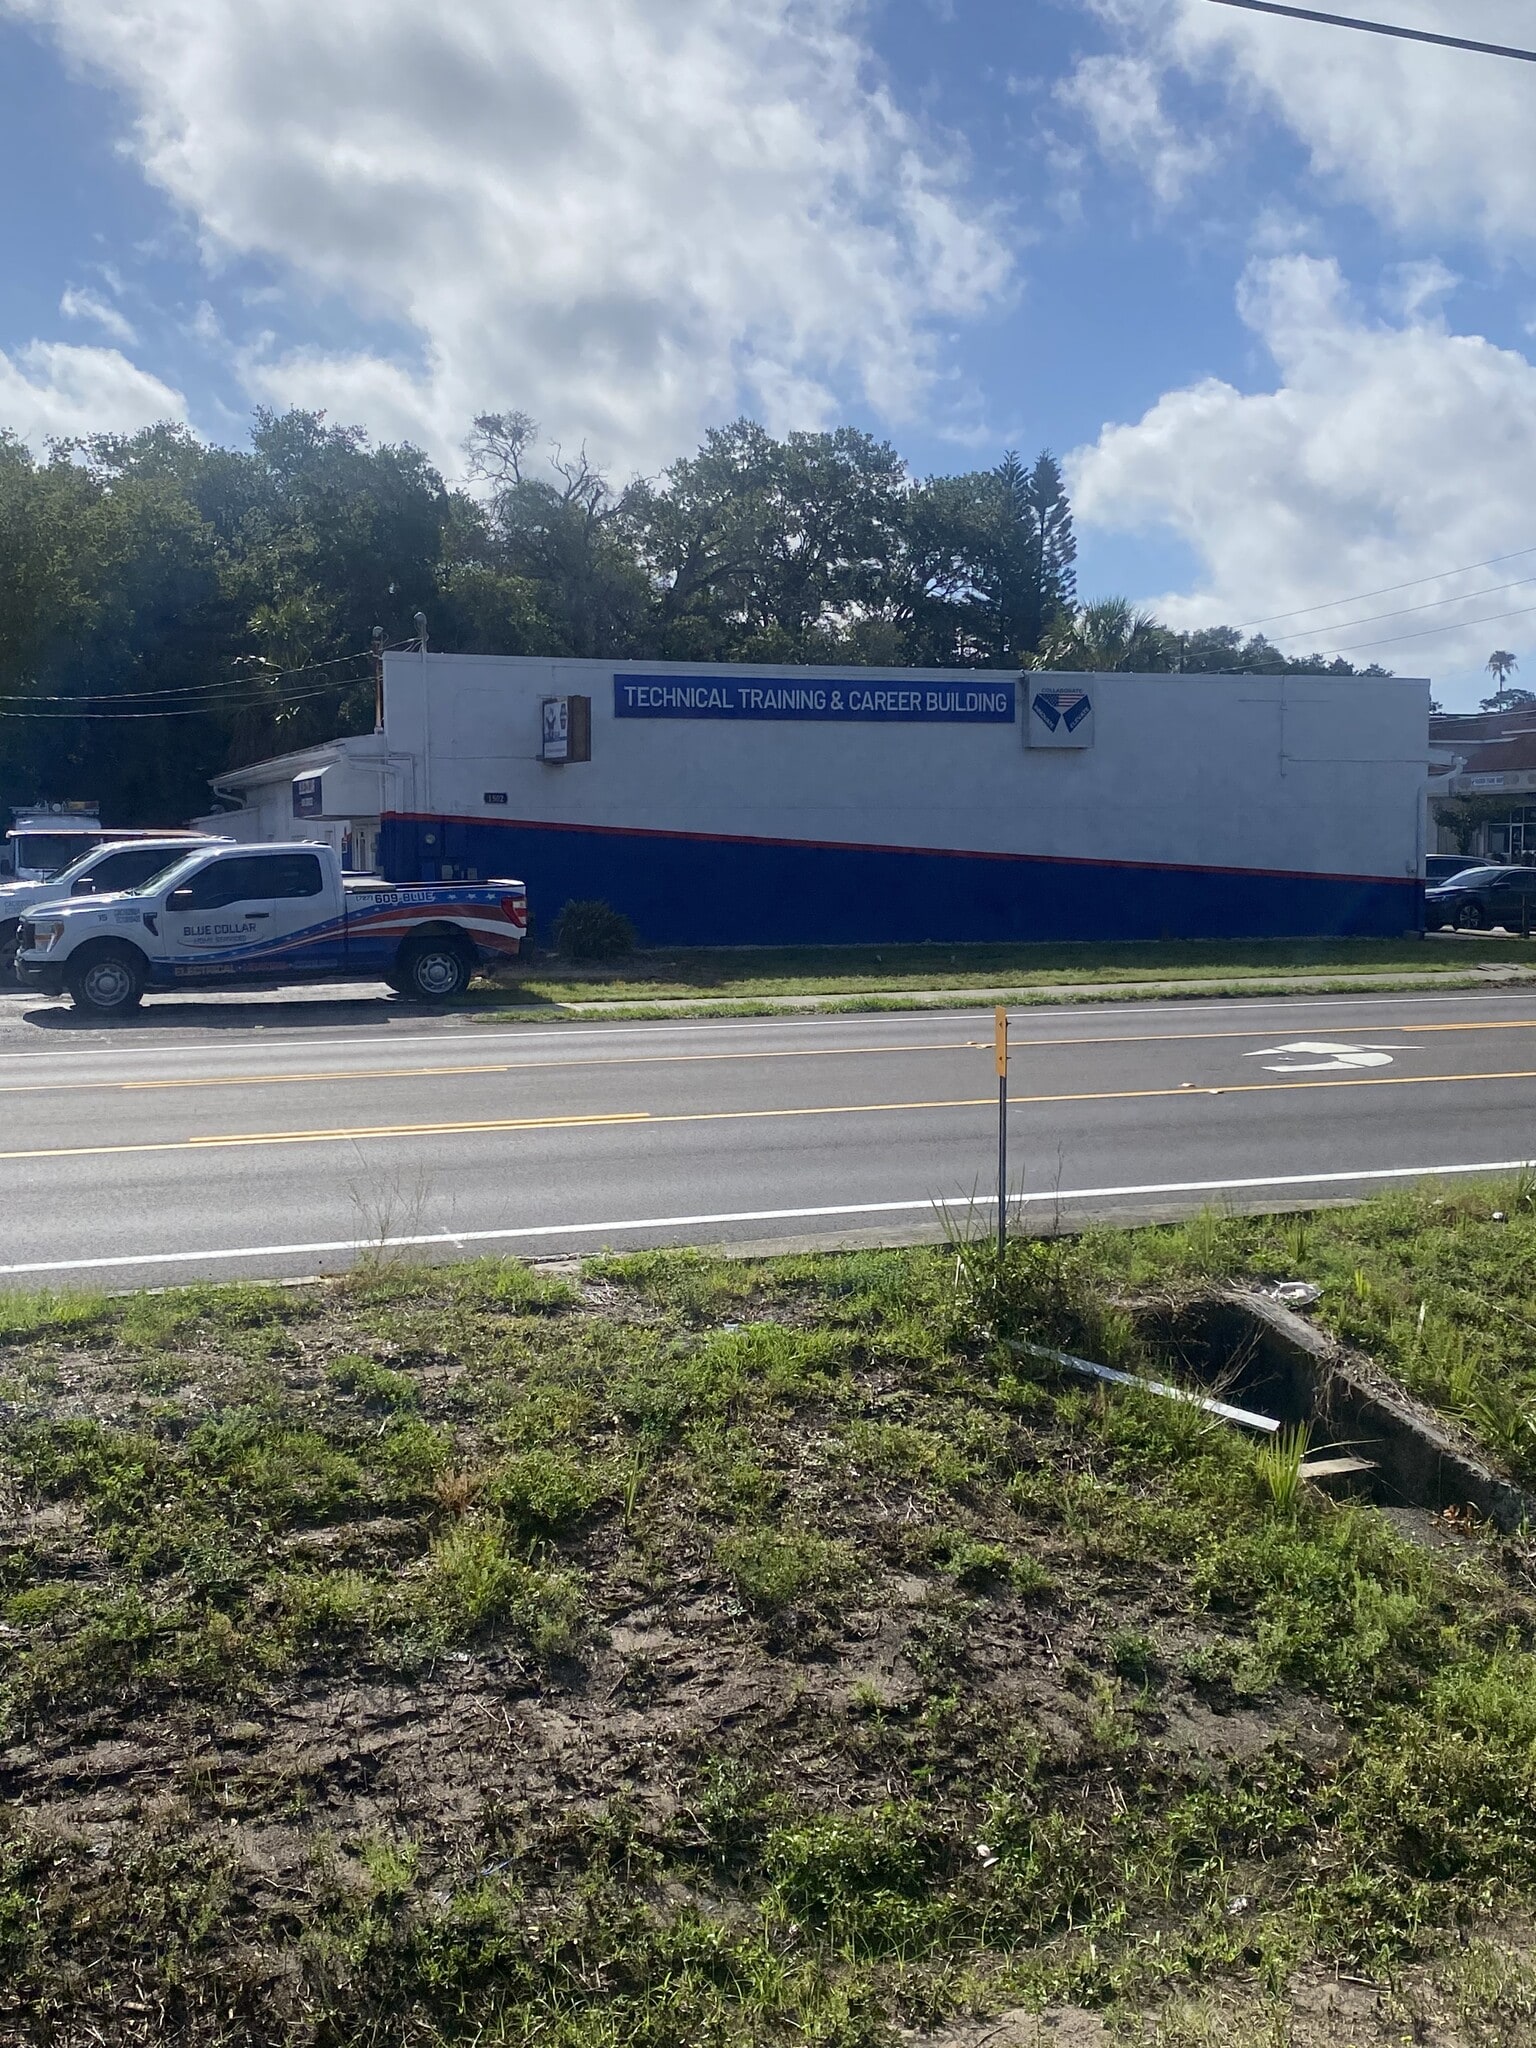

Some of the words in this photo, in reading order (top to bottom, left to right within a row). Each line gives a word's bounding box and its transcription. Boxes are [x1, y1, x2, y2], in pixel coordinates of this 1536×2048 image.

[624, 686, 734, 708] TECHNICAL
[738, 688, 827, 710] TRAINING
[831, 691, 844, 710] &
[849, 691, 922, 711] CAREER
[926, 692, 1007, 712] BUILDING
[183, 925, 212, 936] BLUE
[214, 923, 257, 935] COLLAR
